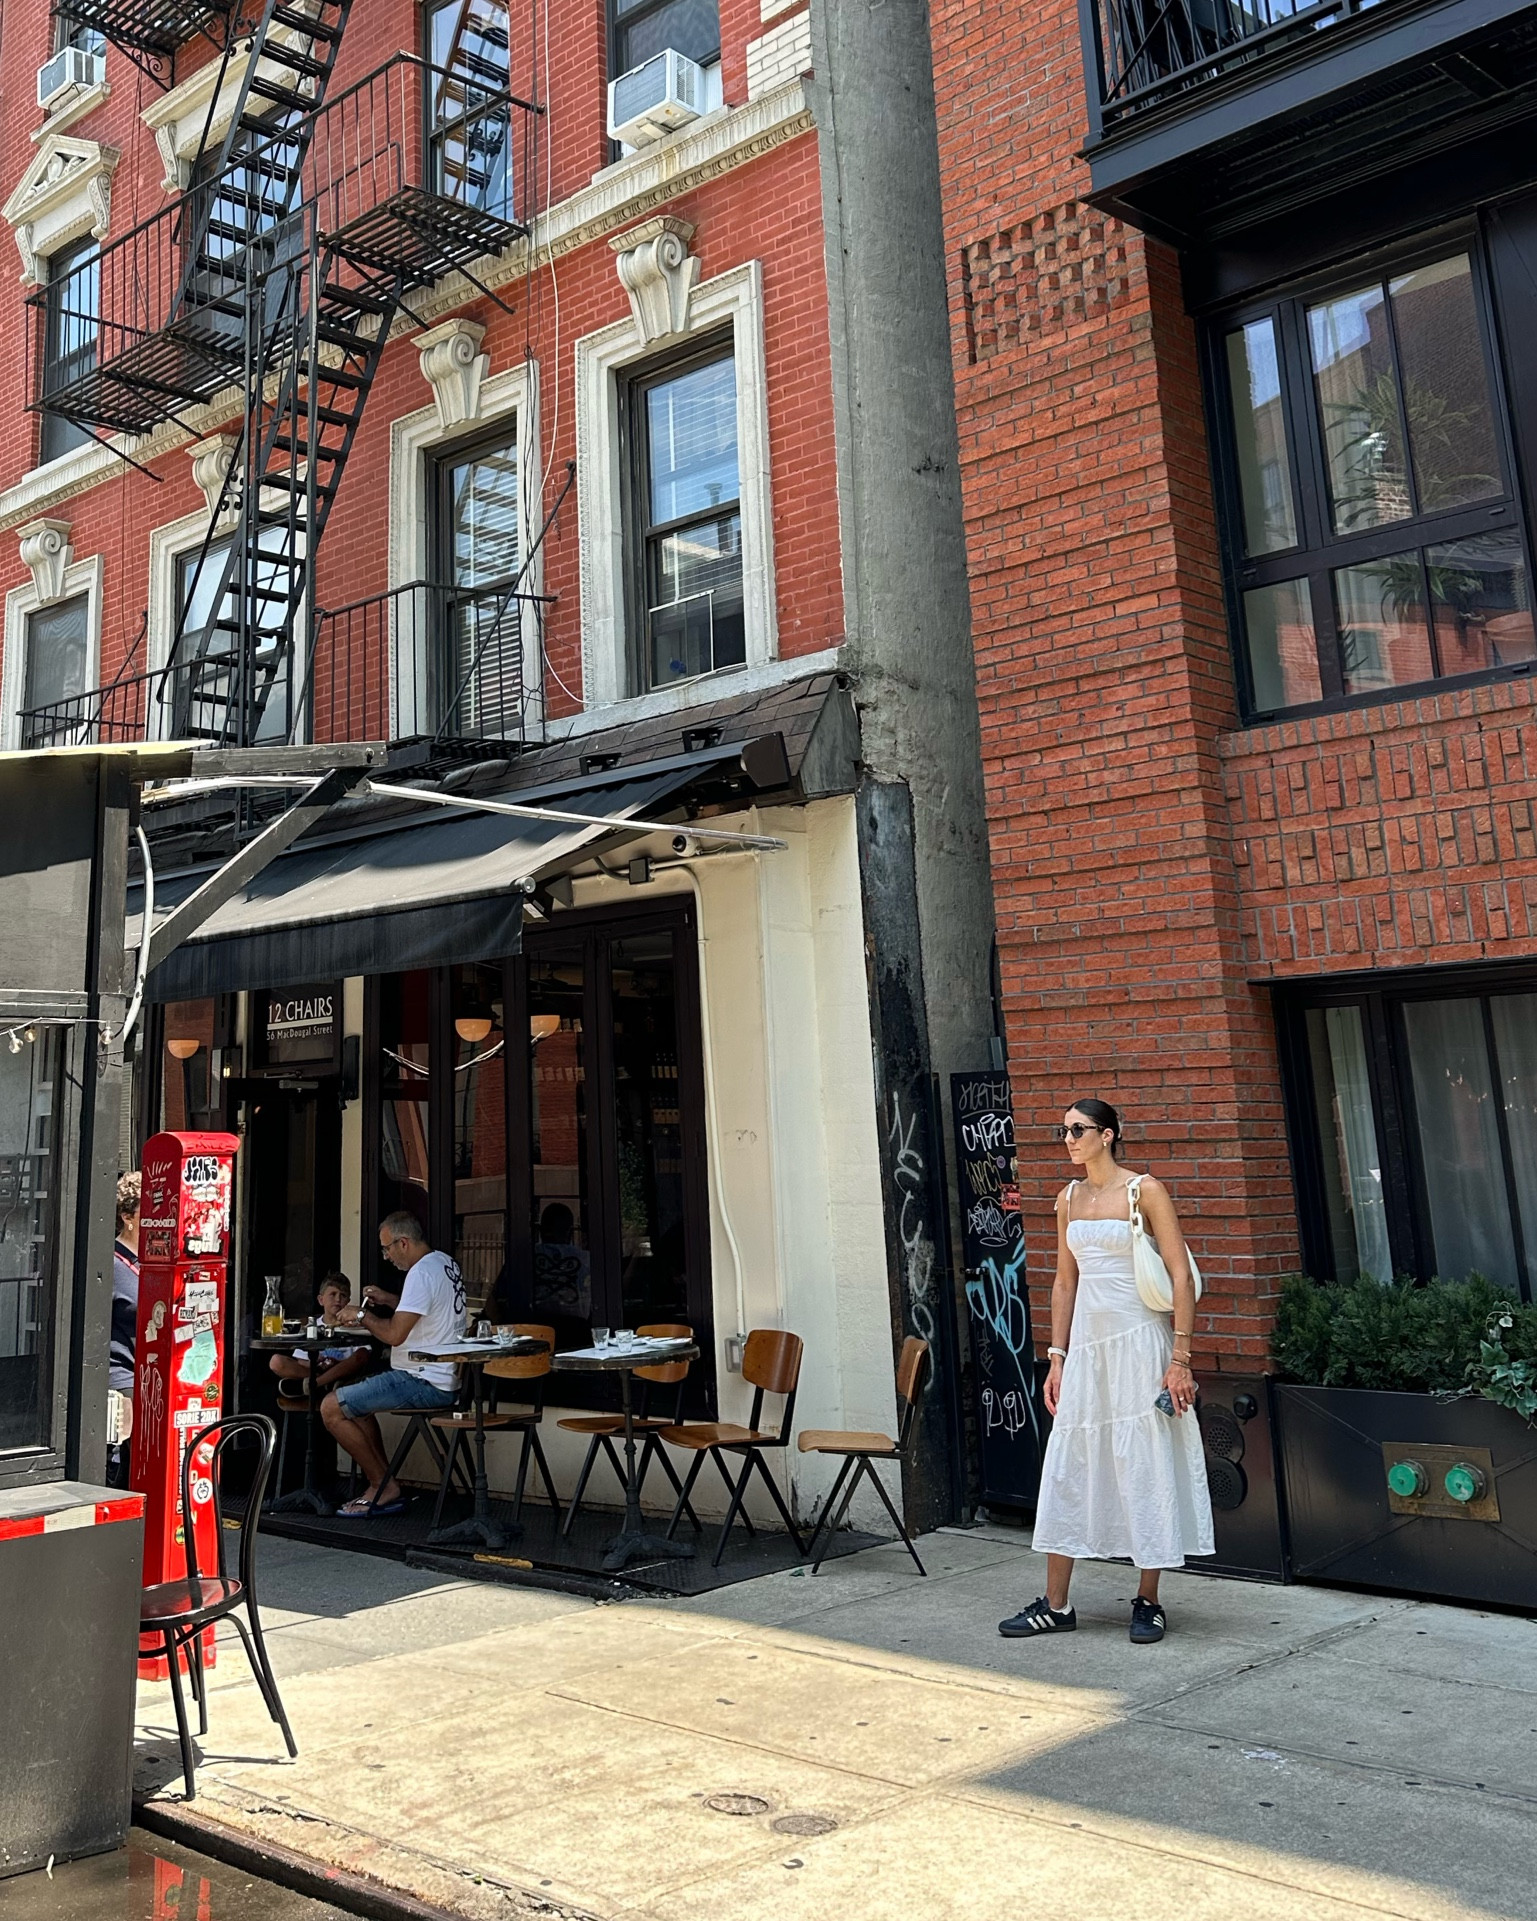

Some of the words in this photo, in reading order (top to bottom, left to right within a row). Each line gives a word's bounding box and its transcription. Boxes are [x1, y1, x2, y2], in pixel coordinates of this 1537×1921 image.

[268, 1003, 282, 1023] 12
[285, 996, 333, 1021] CHAIRS
[266, 1031, 275, 1041] 56
[277, 1026, 311, 1039] MacDougal
[313, 1025, 333, 1035] Street
